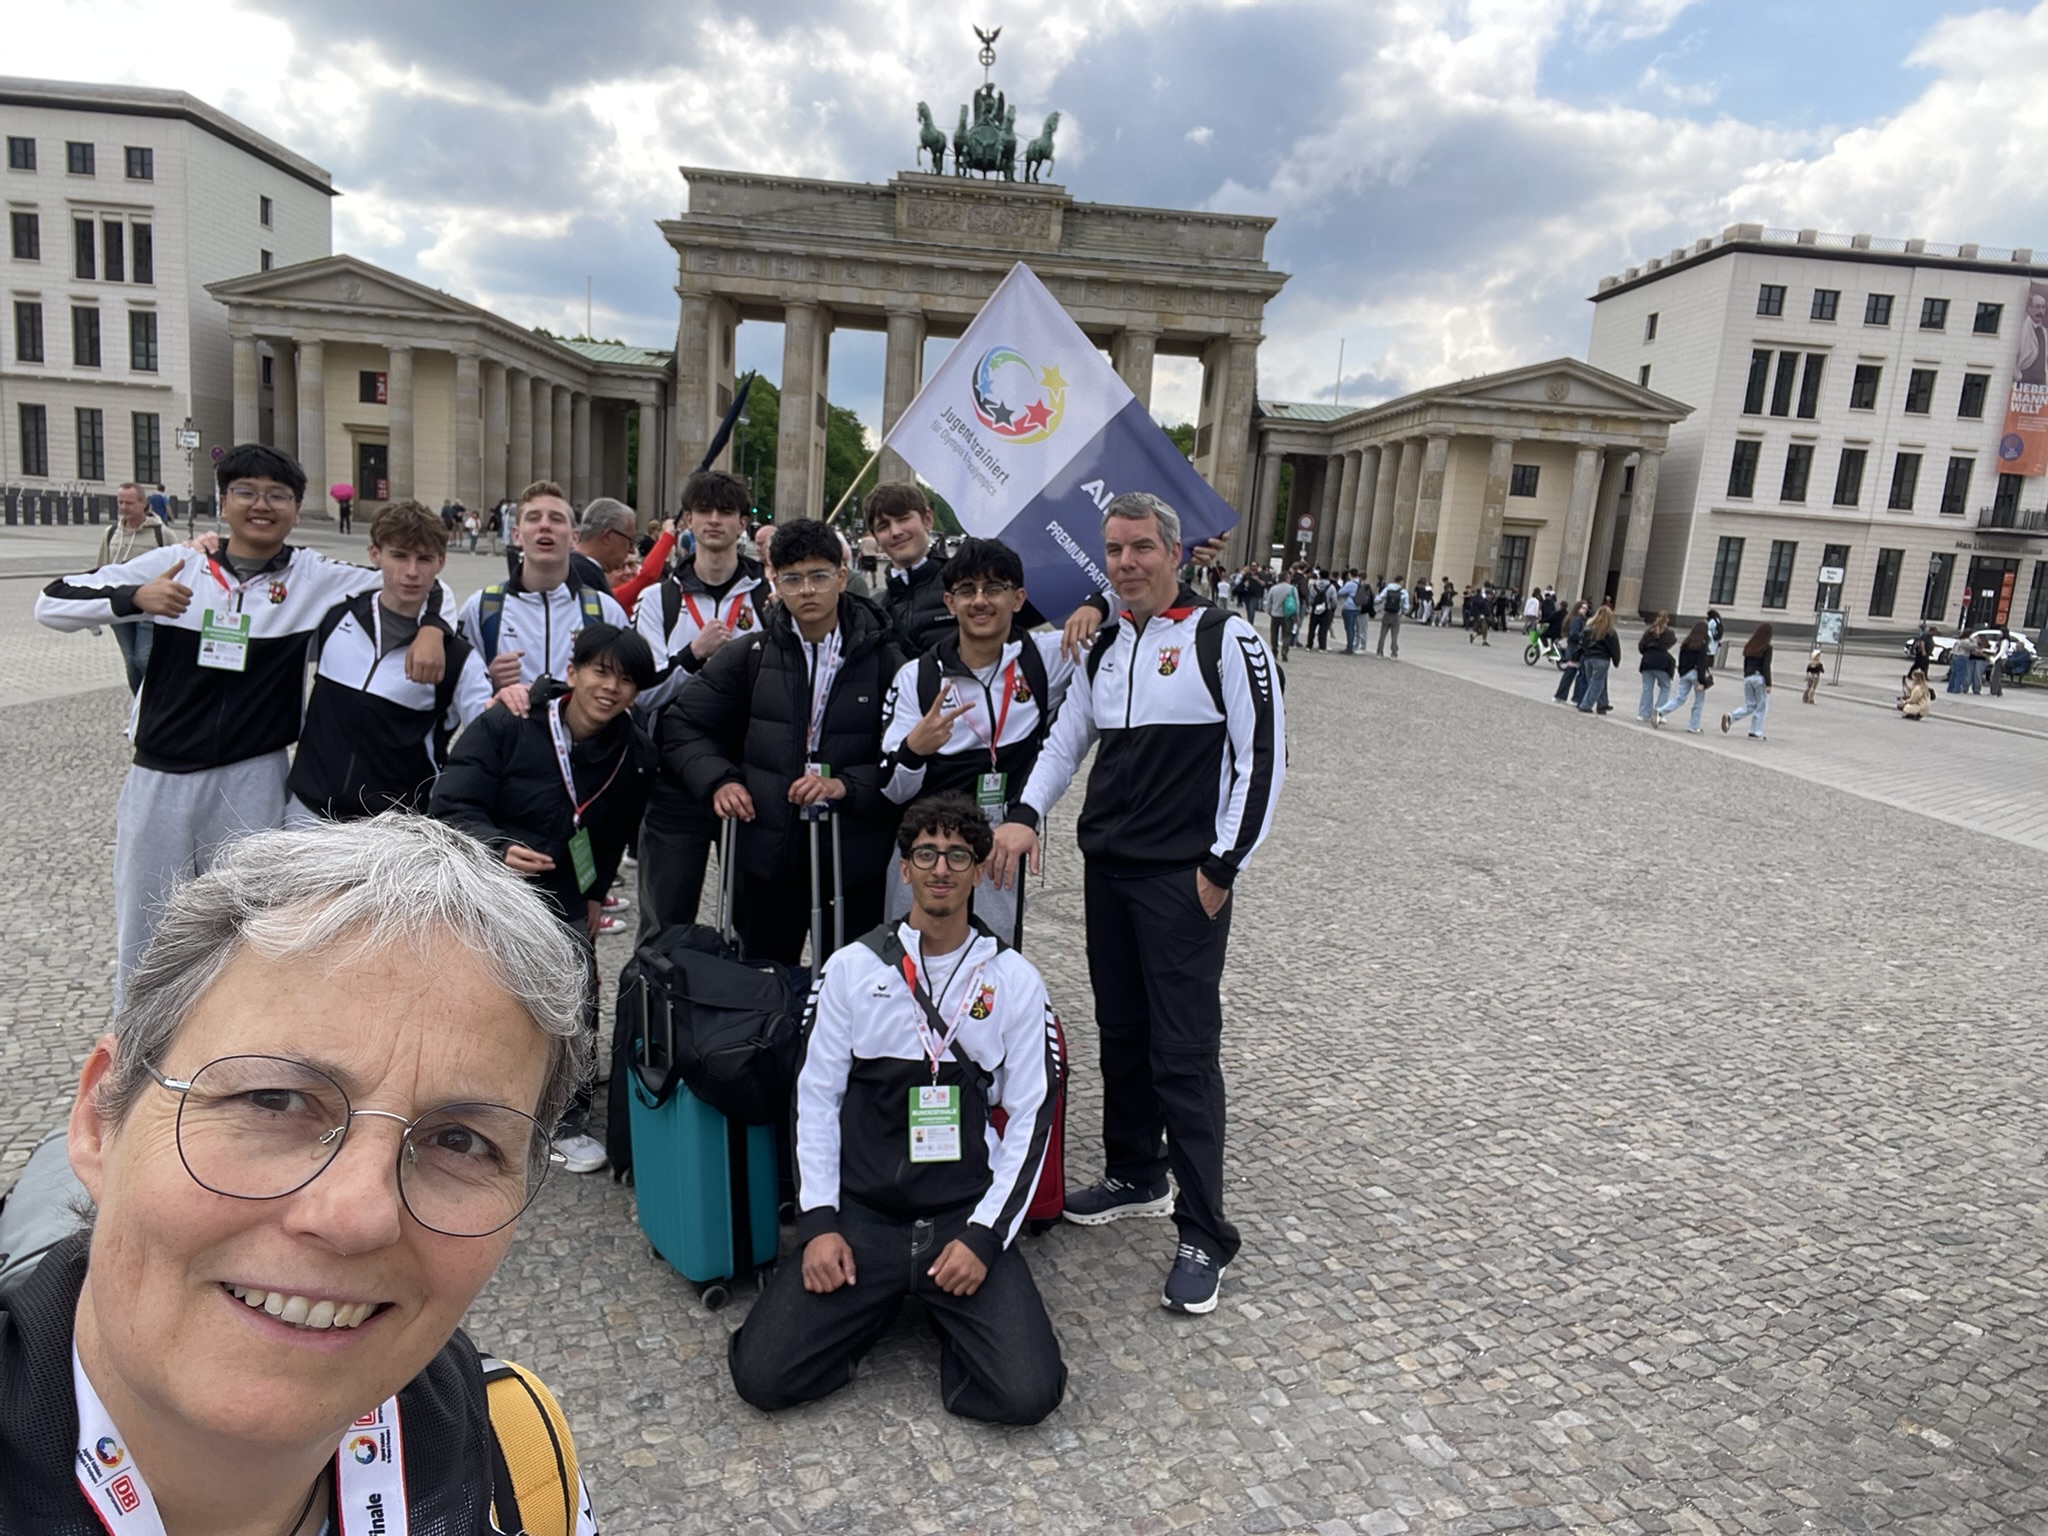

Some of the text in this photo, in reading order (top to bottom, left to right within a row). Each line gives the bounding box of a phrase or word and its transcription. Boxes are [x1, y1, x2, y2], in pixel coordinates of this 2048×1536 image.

[2011, 402, 2042, 414] WELT
[970, 437, 1010, 485] trainiert
[1080, 479, 1115, 515] AI
[1046, 520, 1090, 568] PREMIUM
[114, 1478, 138, 1509] DB
